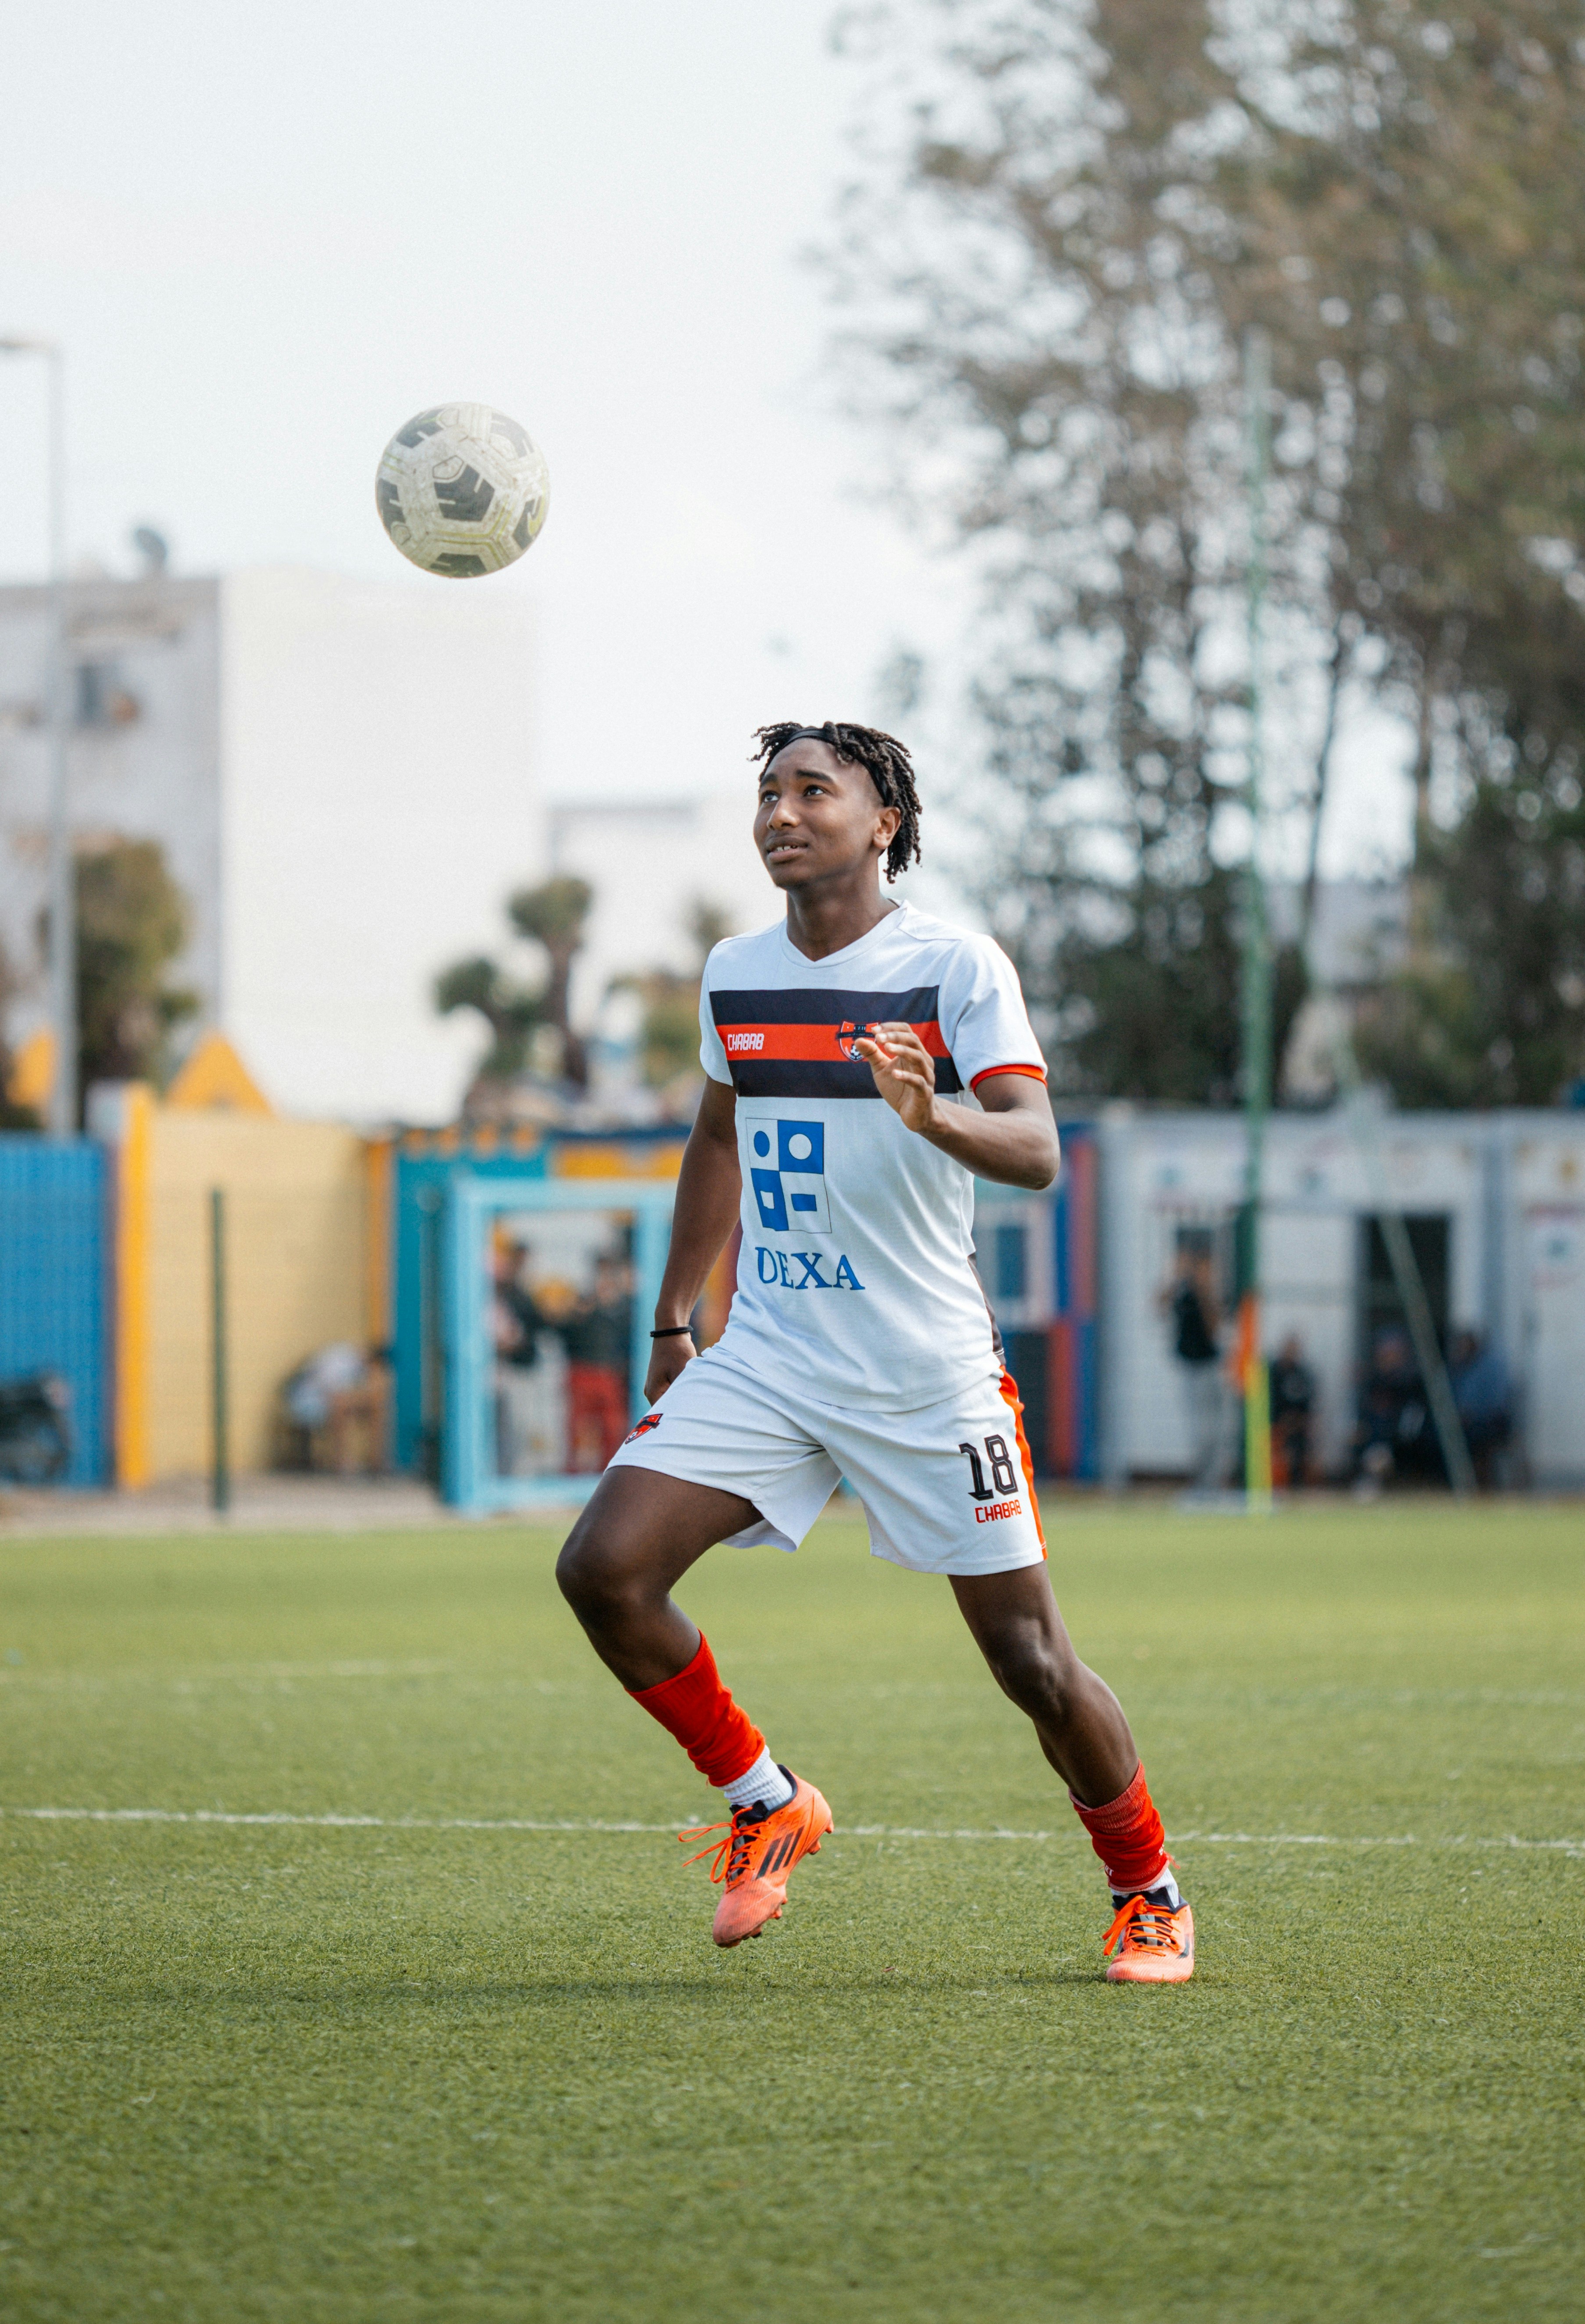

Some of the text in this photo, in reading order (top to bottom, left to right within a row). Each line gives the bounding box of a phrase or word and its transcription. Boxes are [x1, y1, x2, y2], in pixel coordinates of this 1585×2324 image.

[728, 1033, 764, 1051] CHABAB
[755, 1247, 866, 1290] DEXA
[958, 1434, 1019, 1501] 18
[975, 1499, 1022, 1523] CHABAB
